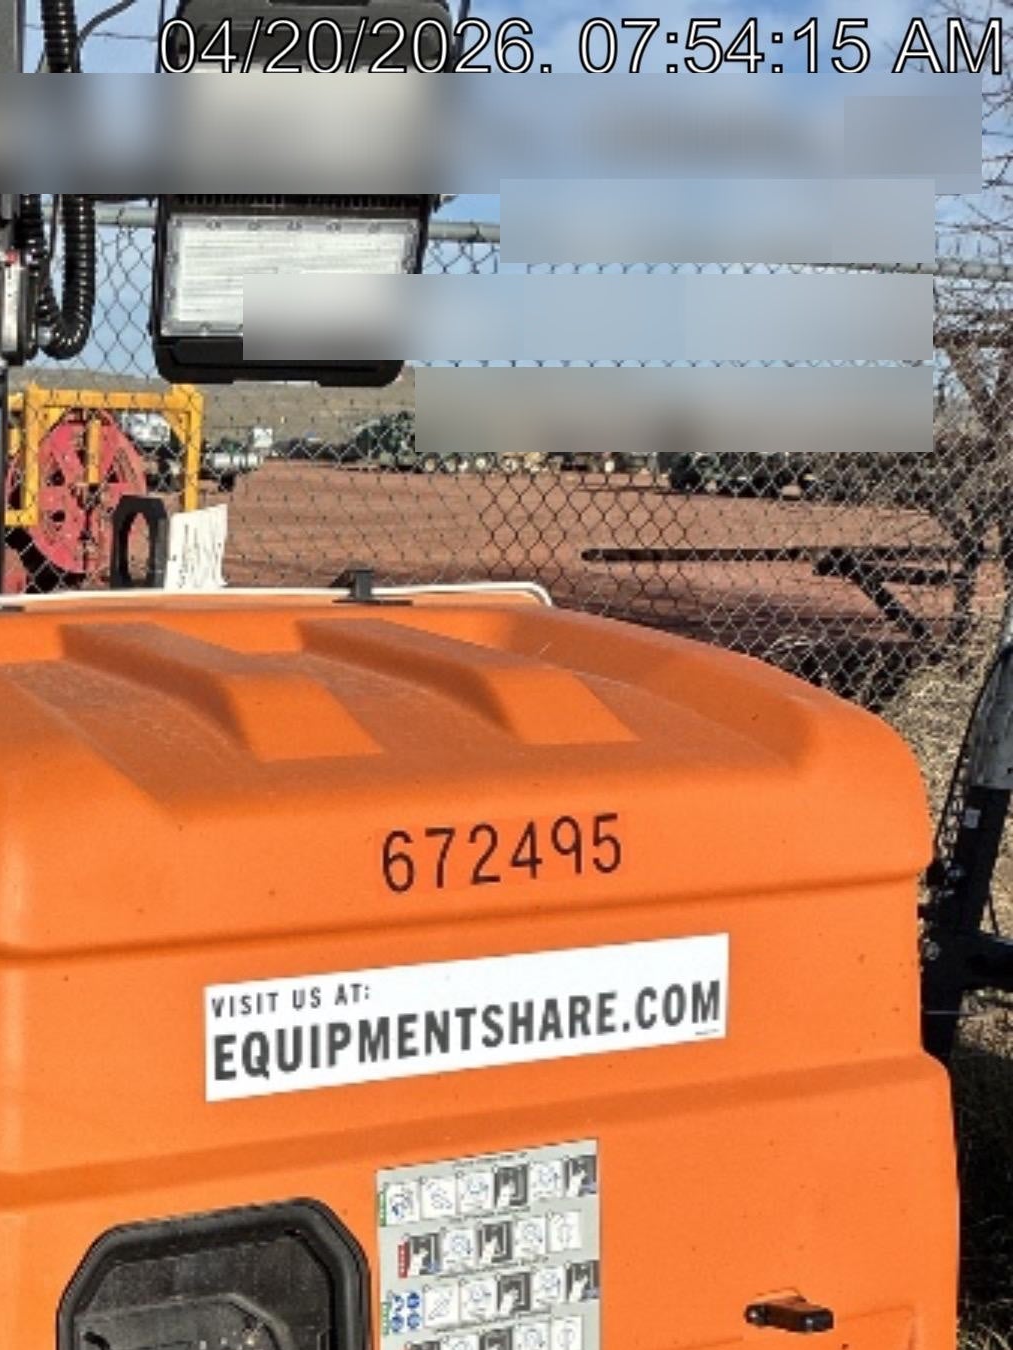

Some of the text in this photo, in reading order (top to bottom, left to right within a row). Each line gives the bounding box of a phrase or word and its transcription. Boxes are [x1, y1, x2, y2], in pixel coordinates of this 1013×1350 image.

[382, 812, 622, 892] 672495
[212, 983, 371, 1019] VISIT US AT:
[213, 979, 721, 1081] EQUIPMENTSHARE.COM
